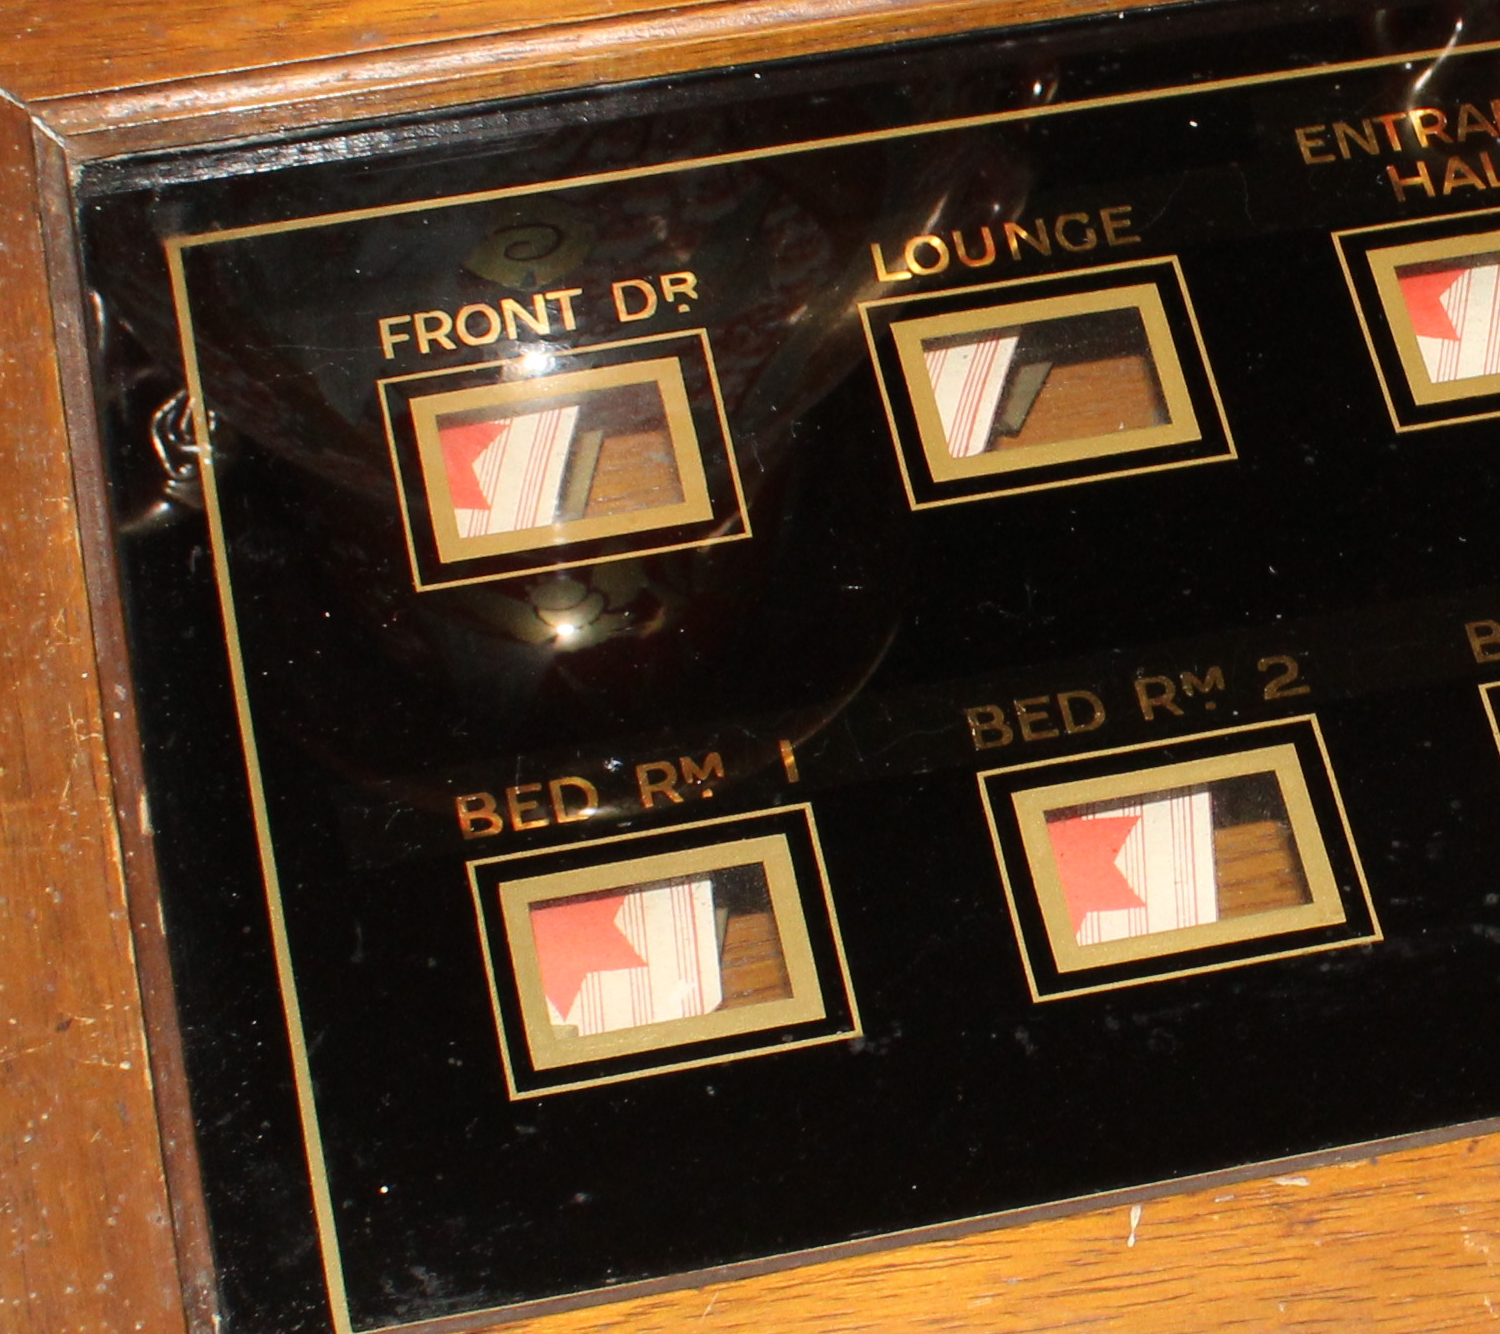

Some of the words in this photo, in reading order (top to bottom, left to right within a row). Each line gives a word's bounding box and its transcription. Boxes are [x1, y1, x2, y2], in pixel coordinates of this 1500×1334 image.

[871, 205, 1143, 283] LOUNGE
[377, 288, 583, 360] FRONT
[965, 688, 1105, 753] BED
[1257, 654, 1311, 701] 2
[456, 775, 600, 840] BED
